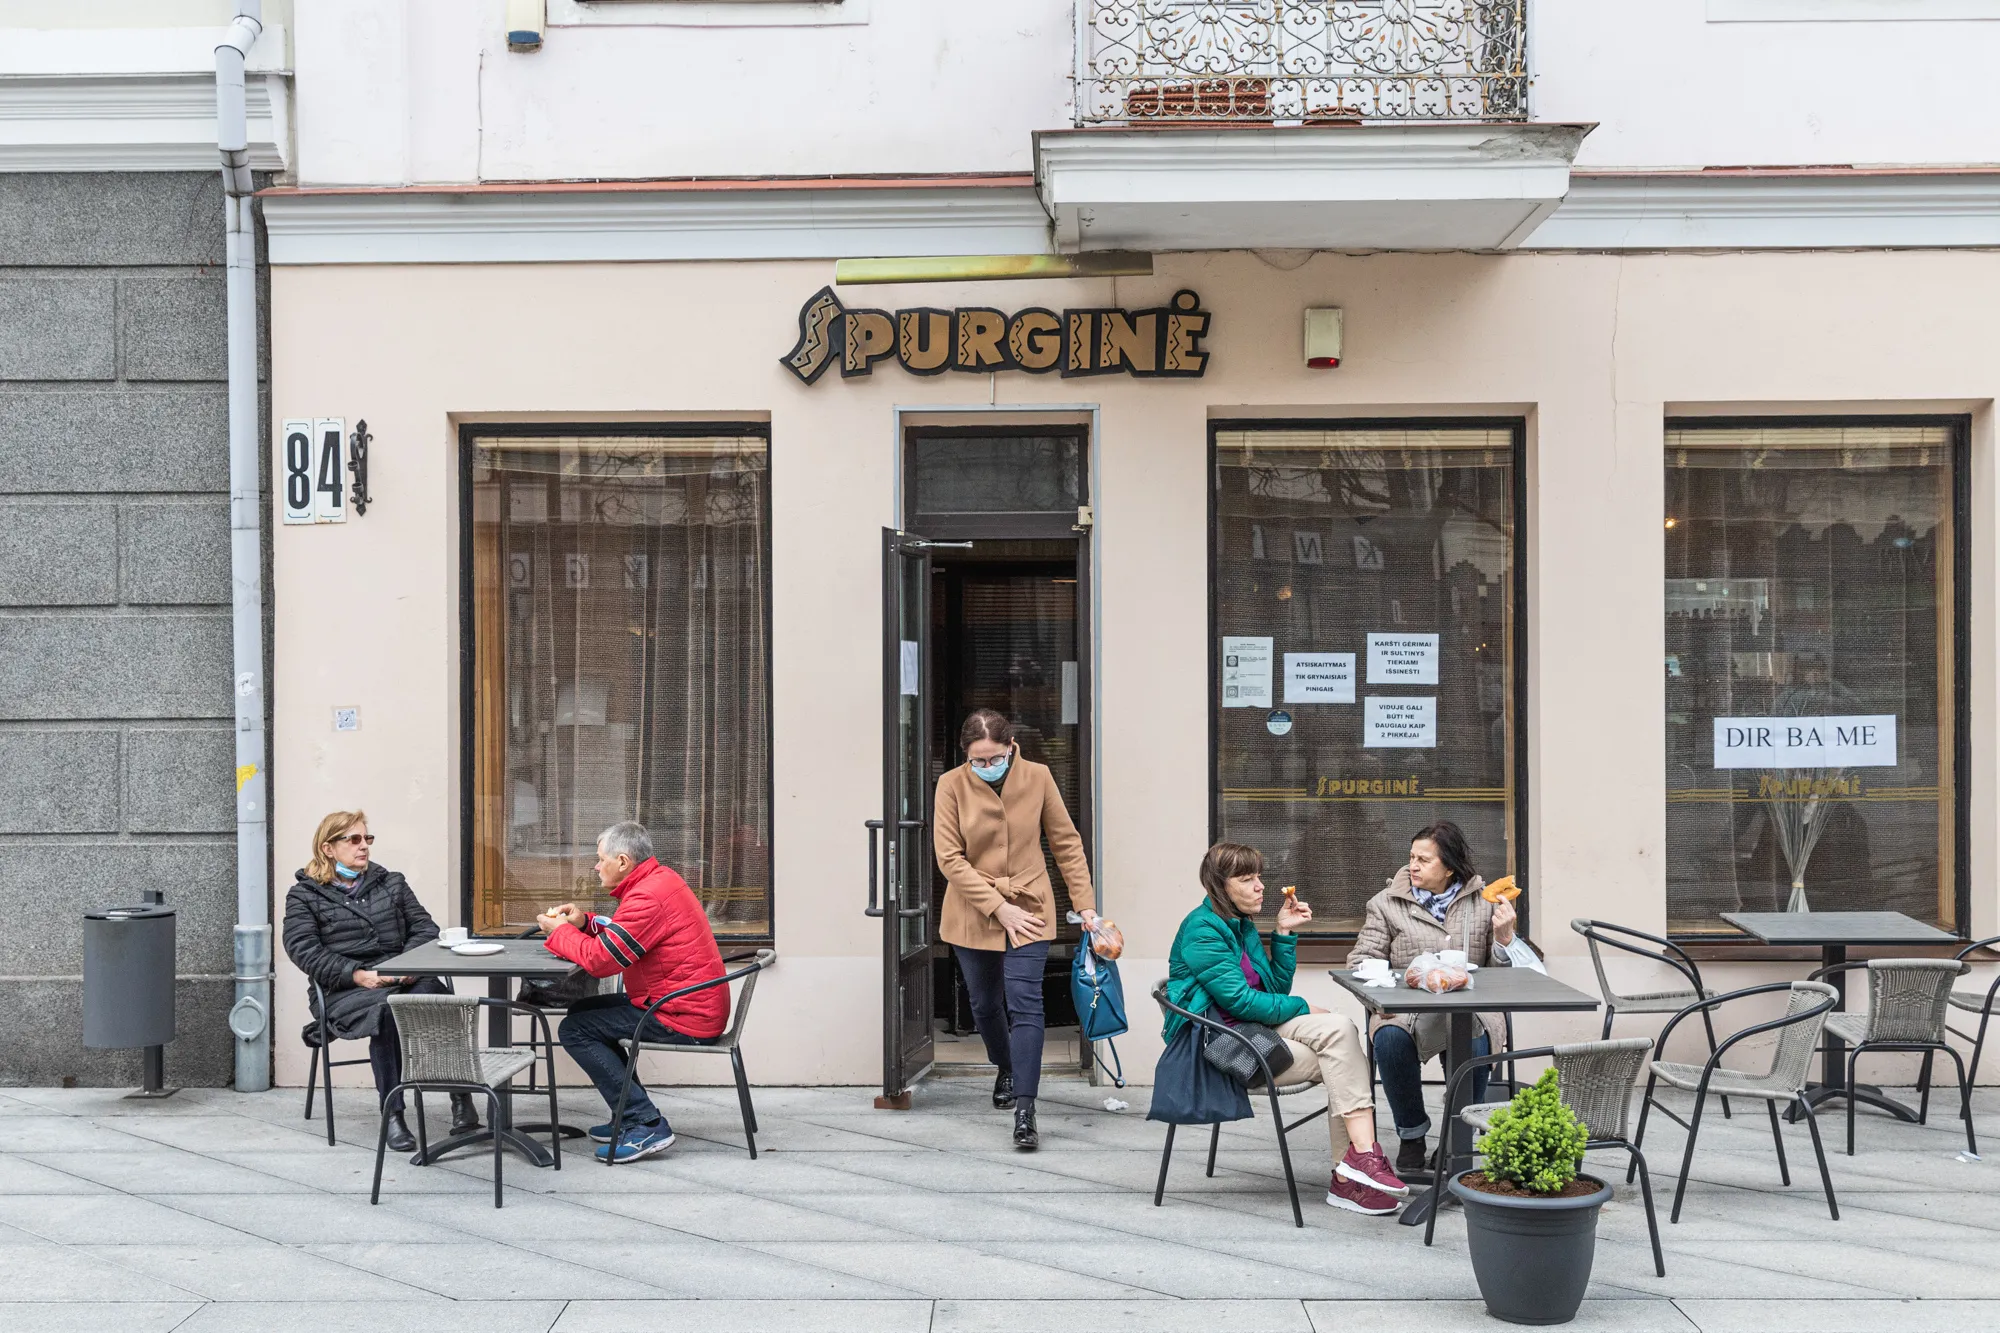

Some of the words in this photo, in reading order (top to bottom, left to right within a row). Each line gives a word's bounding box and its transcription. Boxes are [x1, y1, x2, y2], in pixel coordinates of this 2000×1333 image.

[286, 430, 343, 510] 84
[1386, 667, 1420, 675] IŠSINEŠTI
[1726, 727, 1773, 748] DIR
[1786, 727, 1824, 748] BA
[1836, 725, 1877, 747] ME
